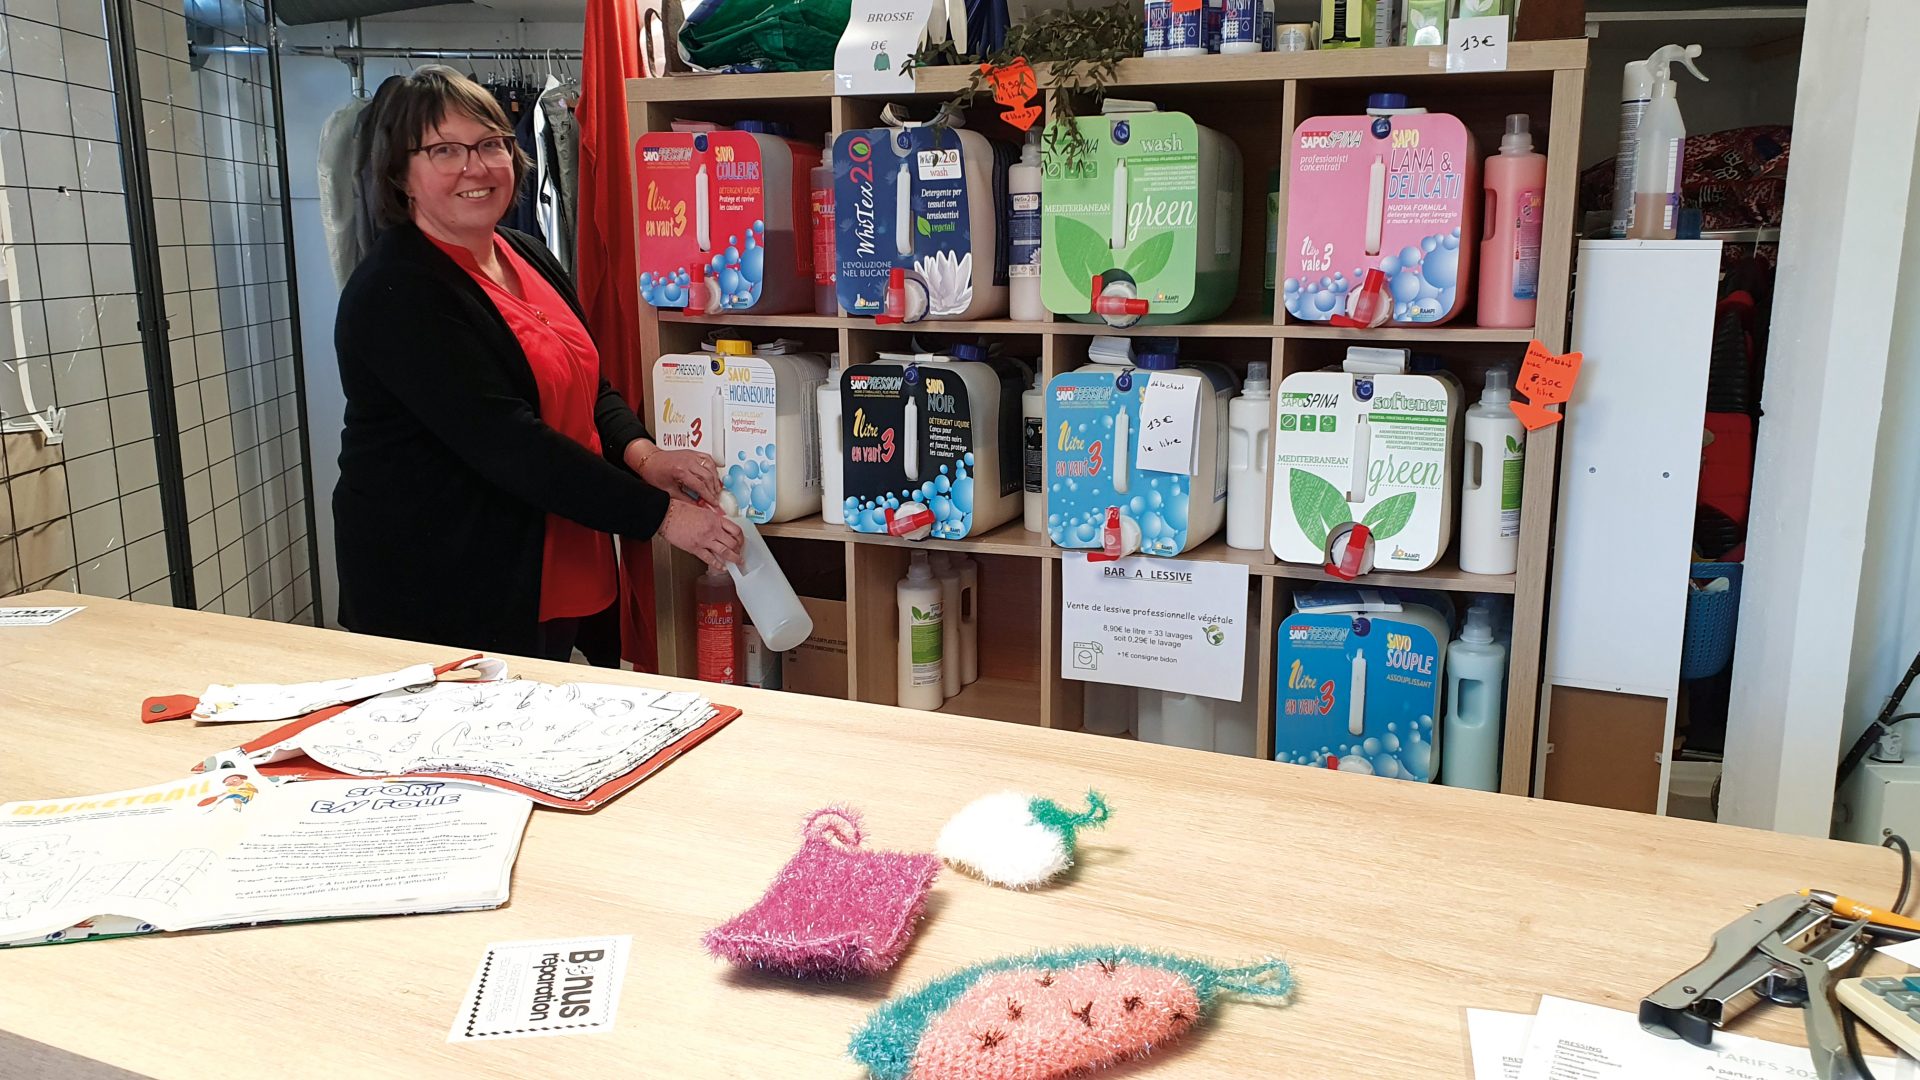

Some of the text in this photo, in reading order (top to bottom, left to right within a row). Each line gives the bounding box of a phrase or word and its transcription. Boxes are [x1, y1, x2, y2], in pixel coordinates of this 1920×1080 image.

[866, 12, 915, 23] BROSSE
[870, 40, 888, 52] 8€
[1461, 35, 1496, 51] 13€
[1140, 132, 1183, 152] wash
[1391, 130, 1419, 148] SAPO
[1300, 154, 1348, 165] professionisti
[1300, 163, 1341, 171] concentrati
[1389, 148, 1452, 173] LANA &
[716, 161, 760, 180] COULEURS
[930, 167, 948, 177] wash
[921, 188, 962, 198] Detergente per
[1388, 173, 1462, 199] DELICATI
[927, 200, 945, 208] tessuti
[1044, 203, 1110, 213] MEDITERRANEAN
[645, 200, 687, 238] en vaut 3
[926, 210, 959, 220] tensioattivi
[1128, 195, 1197, 241] green
[1301, 255, 1321, 271] vale
[1321, 242, 1334, 271] 3
[842, 261, 892, 269] L'EVOLUZIONE
[843, 269, 858, 277] NEL
[728, 367, 750, 382] SAVO
[925, 378, 945, 394] SAVO
[927, 394, 955, 414] NOIR
[1372, 391, 1447, 412] softener
[928, 416, 970, 428] DÉTERGENT LIQUIDE
[1147, 414, 1174, 430] 13€
[663, 417, 703, 447] en vaut 3
[851, 427, 896, 463] en vaut 3
[1143, 445, 1154, 453] le
[1056, 440, 1104, 477] en vaut 3
[1278, 454, 1348, 465] MEDITERRANEAN
[1368, 454, 1443, 497] green
[1104, 566, 1193, 582] BAR A LESSIVE
[1066, 601, 1233, 625] Vente de lessive professionnelle végétale
[1103, 624, 1123, 634] 8,90€
[1124, 626, 1131, 634] le
[1132, 626, 1146, 635] litre
[1154, 629, 1164, 637] 33
[1165, 629, 1193, 640] lavages
[1113, 634, 1182, 648] soit 0,29€ le lavage
[1387, 632, 1412, 652] SAVO
[1130, 653, 1158, 662] consigne
[1159, 655, 1178, 664] bidon
[1385, 648, 1434, 675] SOUPLE
[1386, 673, 1433, 688] ASSOUPLISSANT
[1285, 679, 1336, 716] en vaut 3
[12, 779, 211, 816] BASKETBALL
[345, 782, 446, 797] SPORT
[310, 793, 462, 814] EN FOLIE
[528, 952, 566, 1022] réparation
